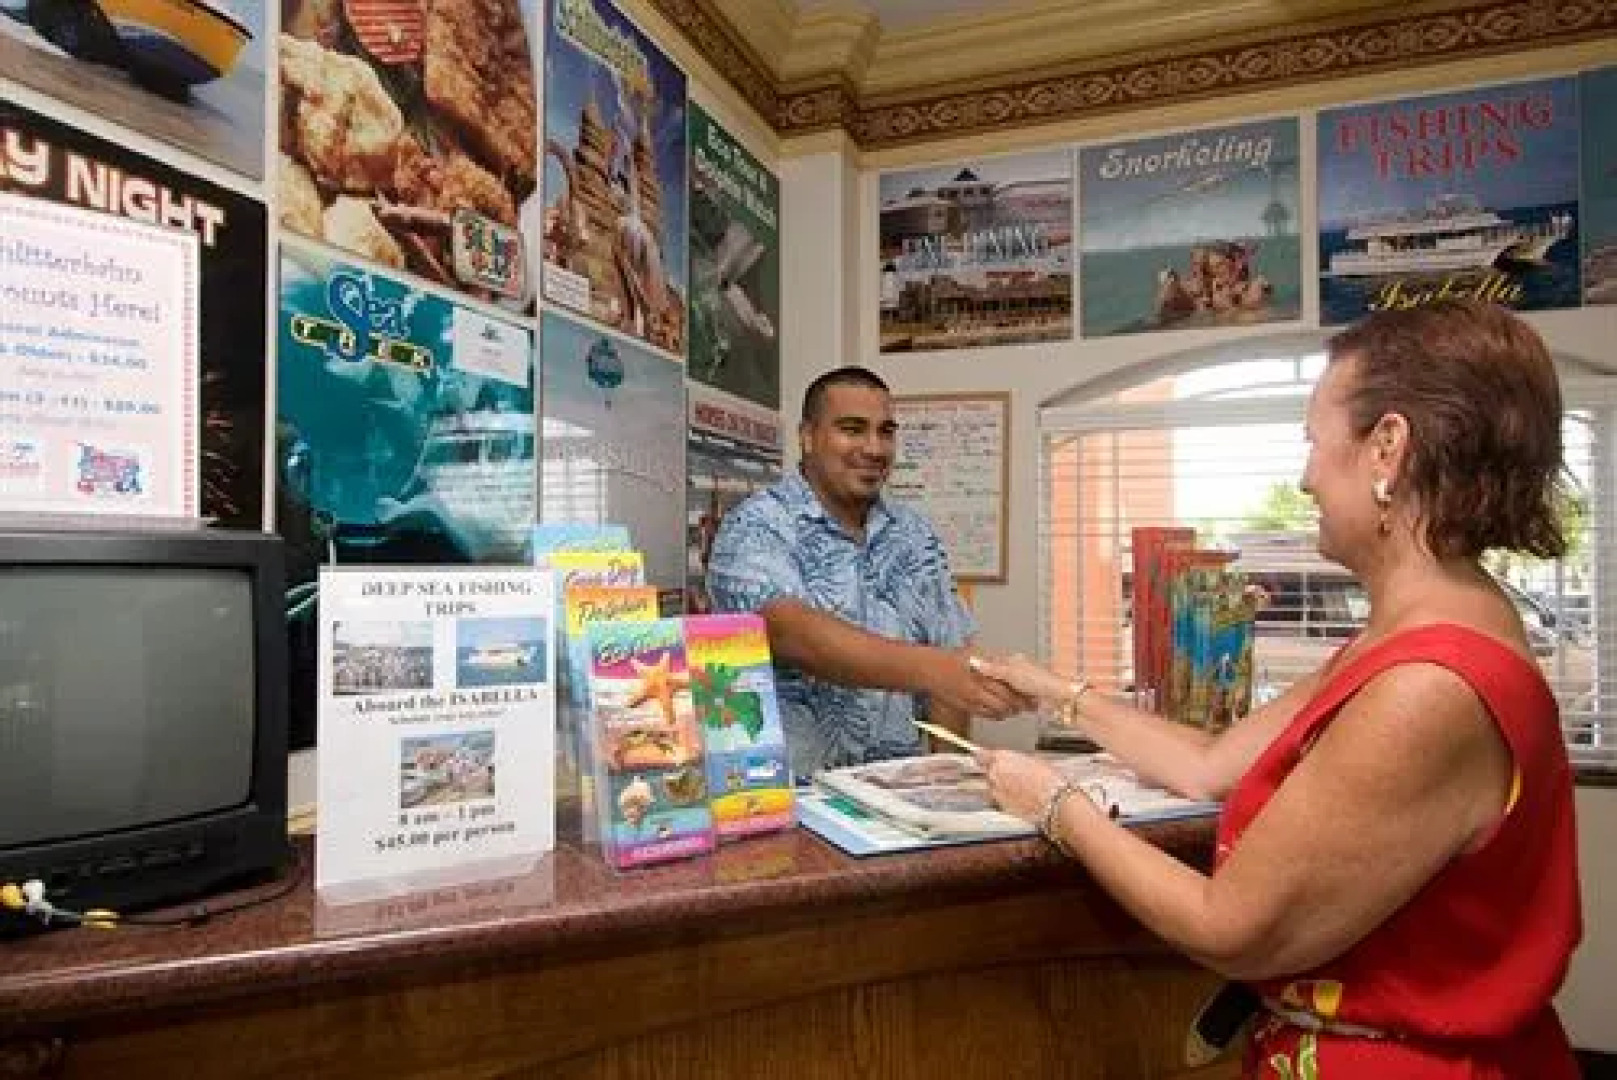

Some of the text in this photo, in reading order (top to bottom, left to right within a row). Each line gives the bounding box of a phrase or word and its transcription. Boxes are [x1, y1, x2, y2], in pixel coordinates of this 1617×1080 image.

[1337, 93, 1553, 154] FISHING
[1098, 137, 1273, 181] Snorkeling
[1374, 133, 1523, 181] TRIPS
[67, 153, 225, 246] NIGHT
[362, 579, 533, 596] DEEP SEA FISHING
[425, 601, 476, 617] TRIPS
[354, 688, 538, 713] Aboard the ISABELLA
[433, 829, 460, 847] per
[464, 821, 516, 841] person
